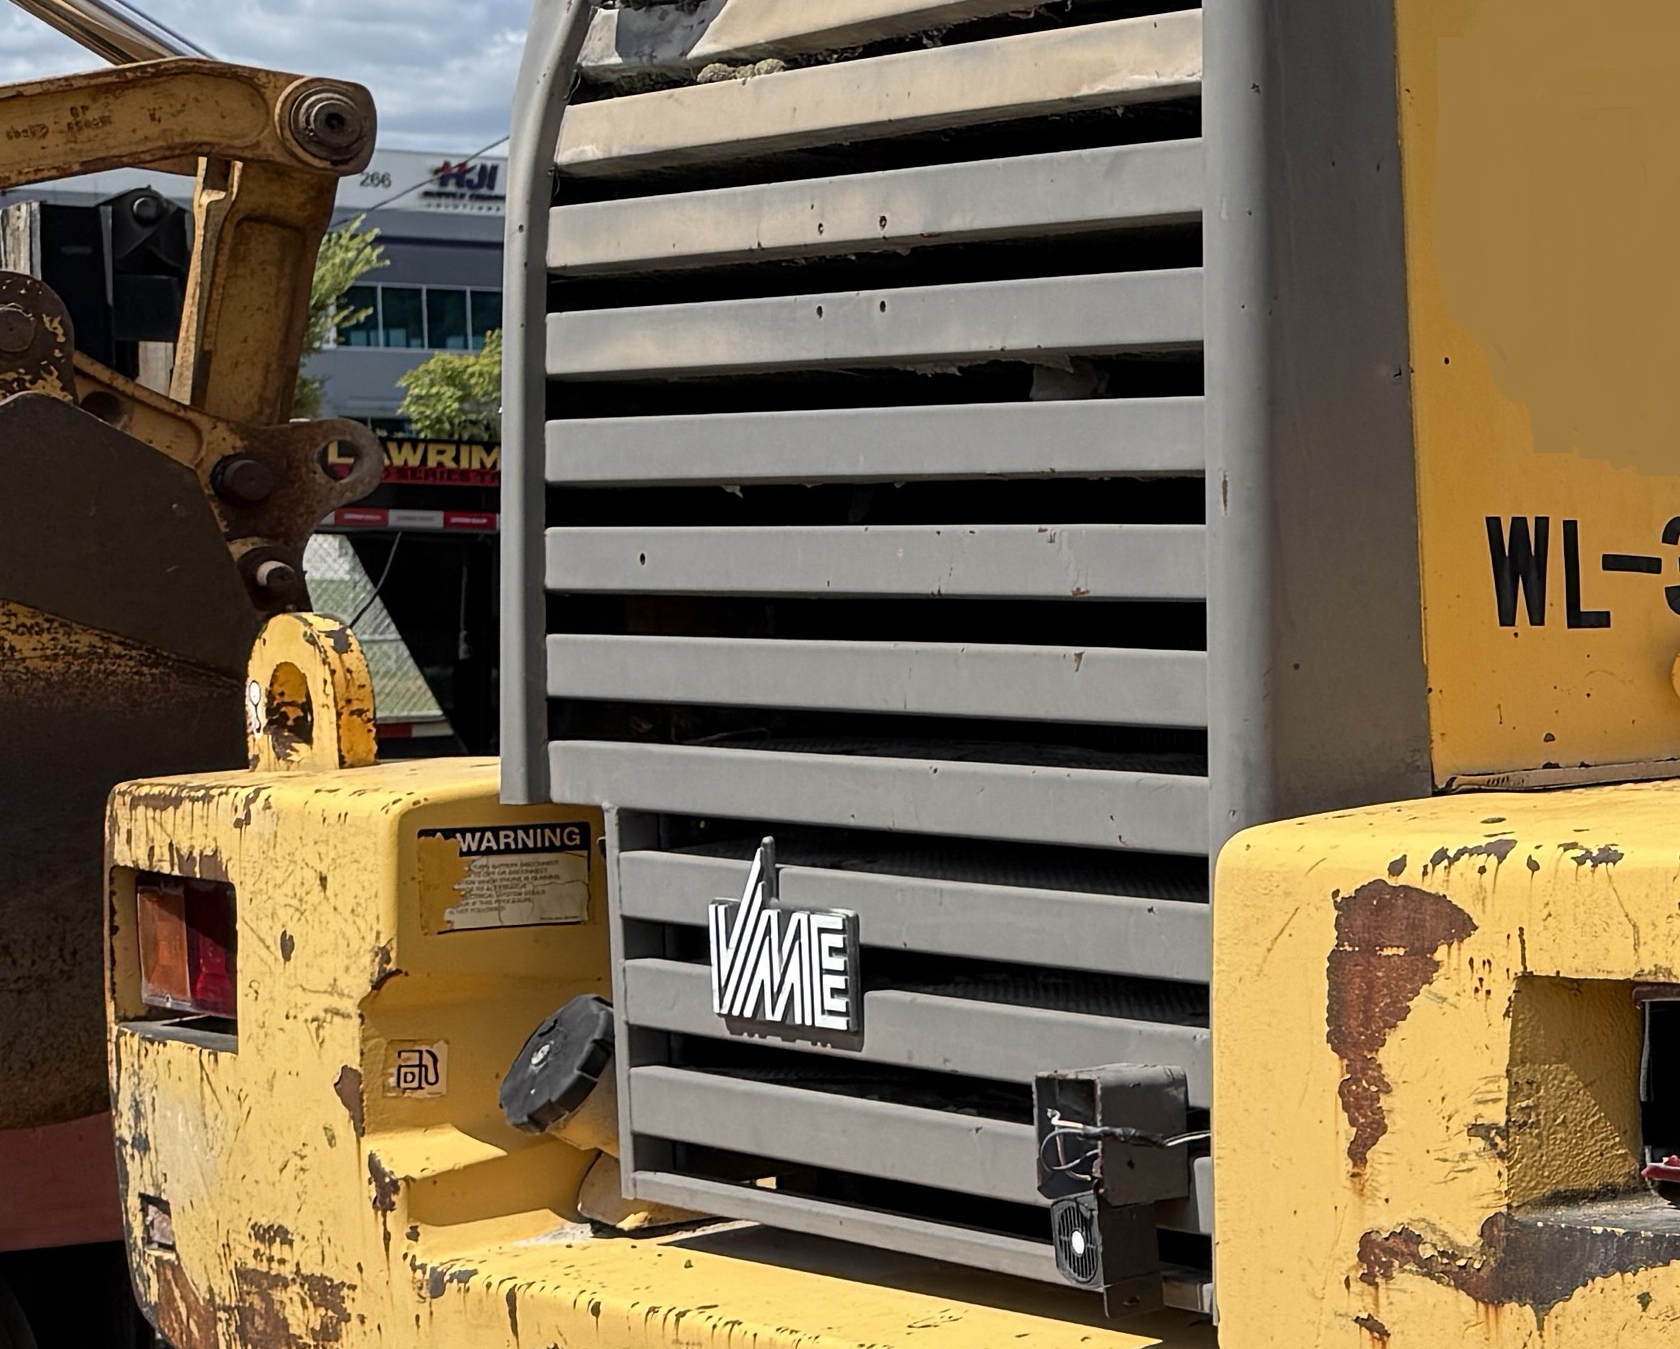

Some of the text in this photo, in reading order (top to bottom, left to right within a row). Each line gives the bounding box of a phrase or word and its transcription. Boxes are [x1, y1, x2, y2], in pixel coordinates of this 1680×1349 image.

[359, 172, 392, 188] 266
[456, 826, 582, 853] WARNING
[708, 846, 850, 1032] VME
